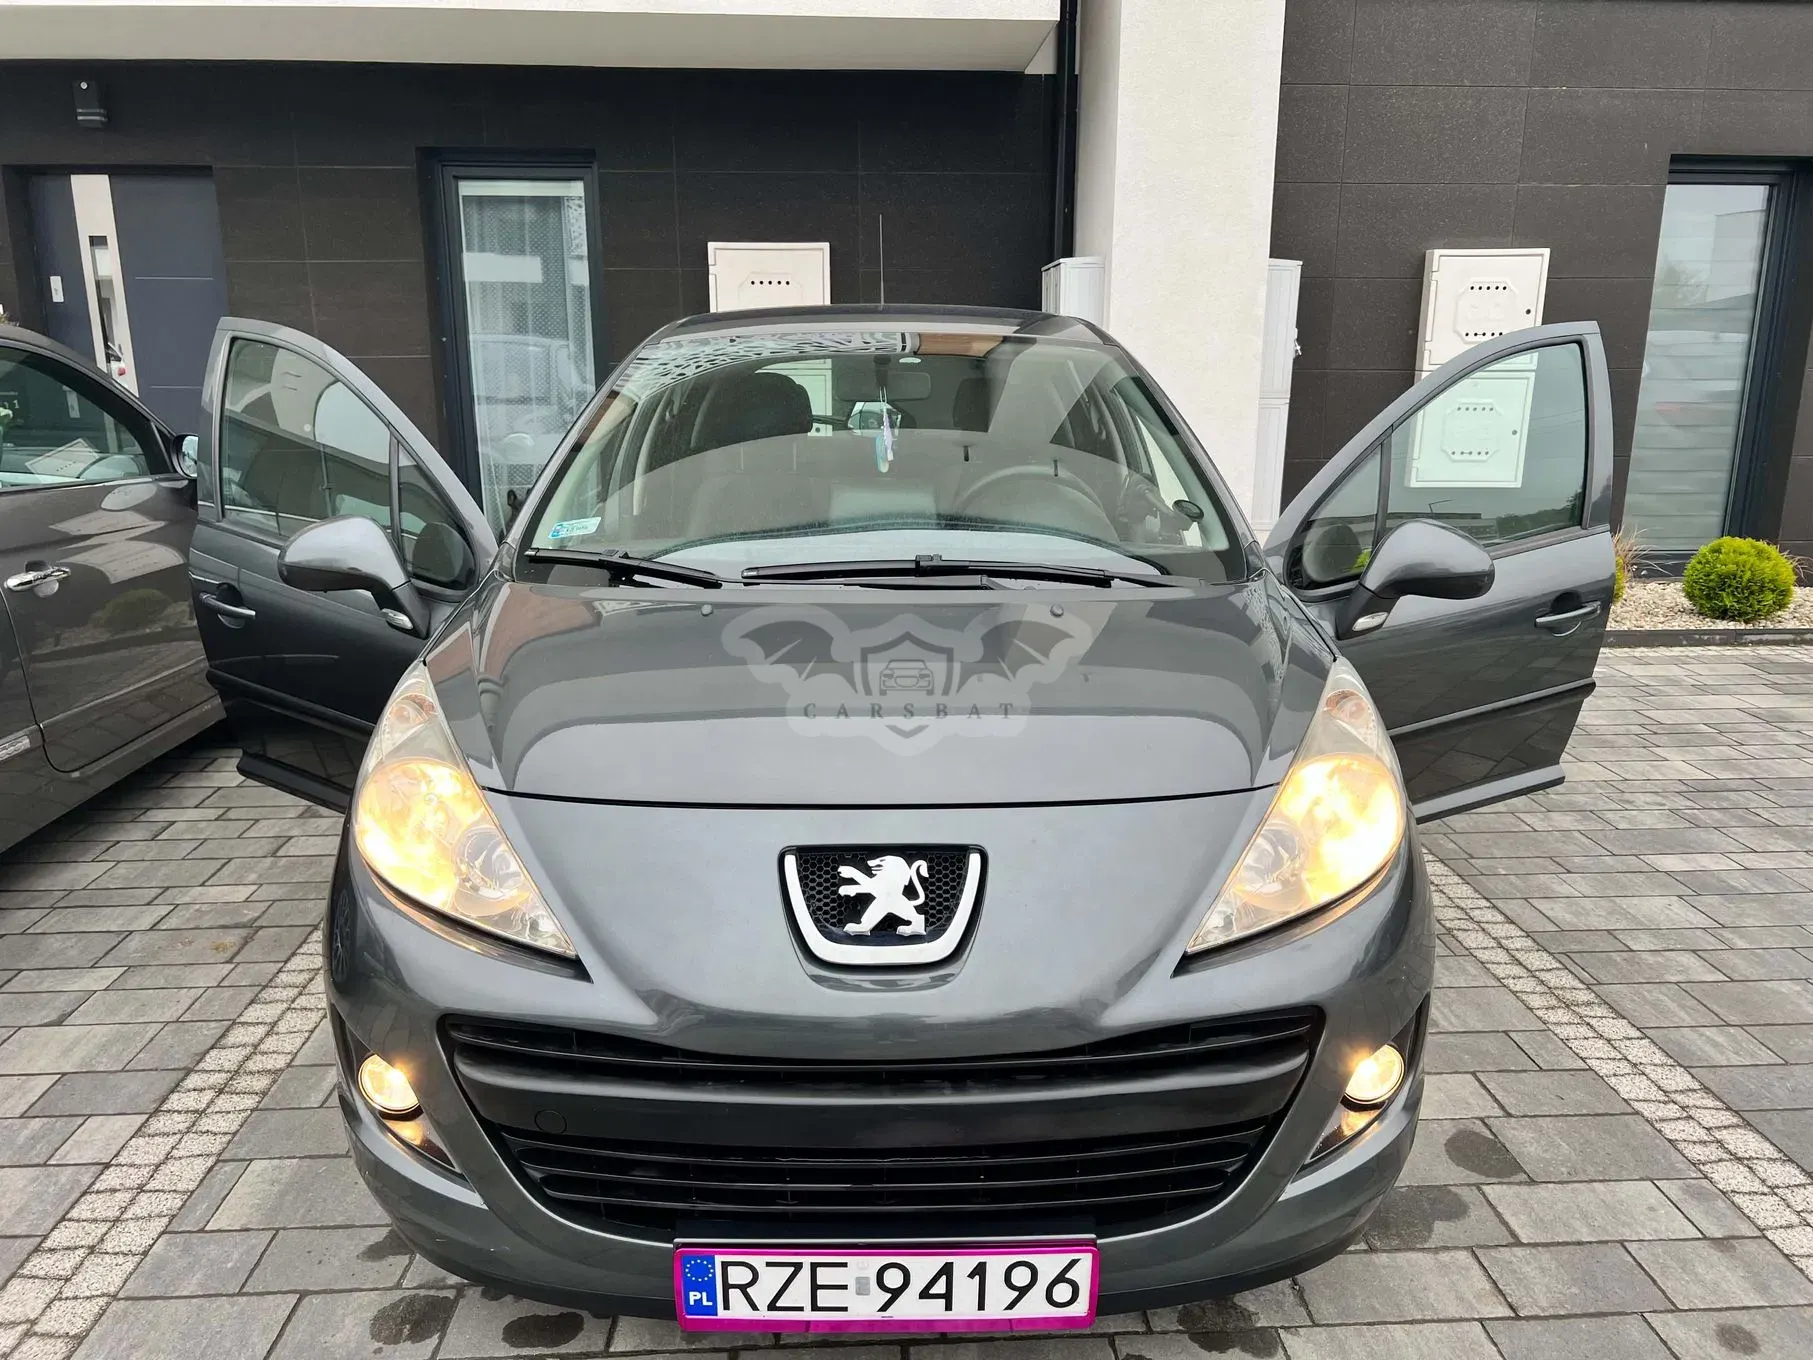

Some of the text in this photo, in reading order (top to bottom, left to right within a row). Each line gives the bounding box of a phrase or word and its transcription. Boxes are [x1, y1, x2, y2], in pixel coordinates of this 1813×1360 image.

[689, 1292, 713, 1306] PL
[721, 1258, 1082, 1312] RZE 94196
